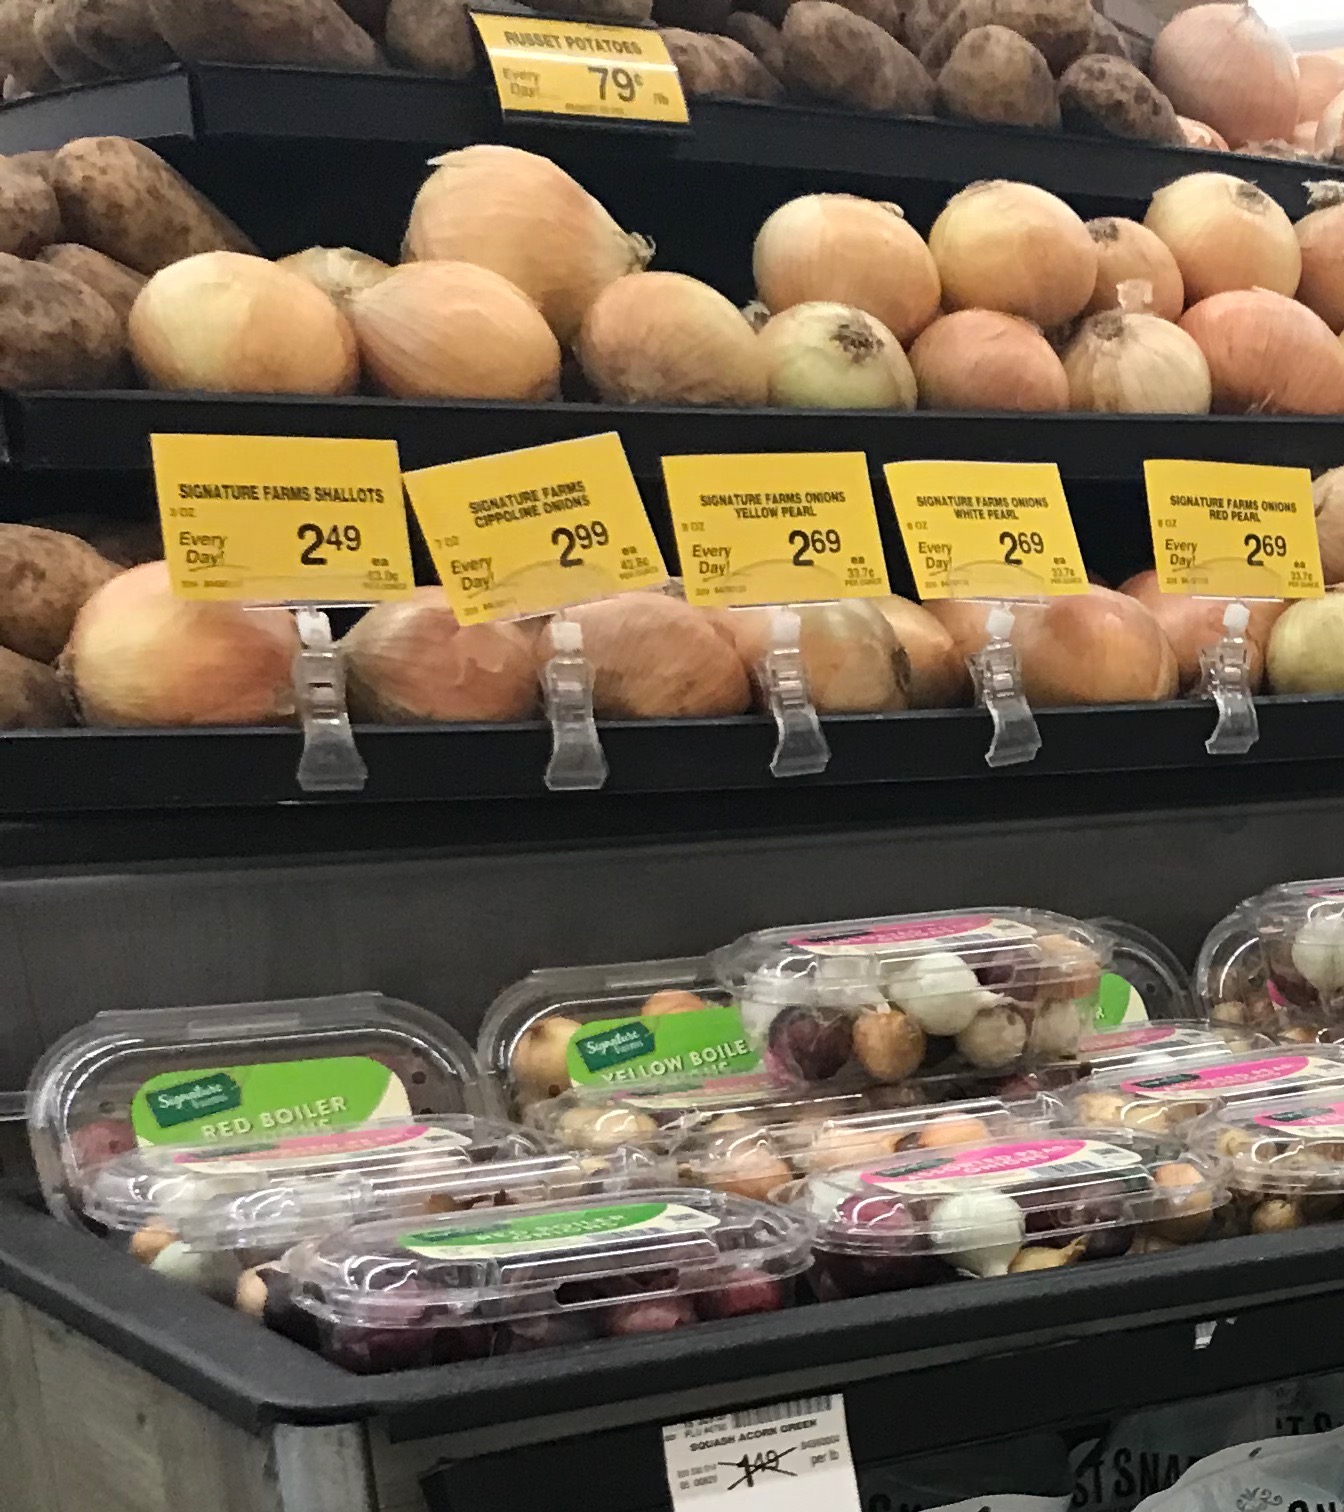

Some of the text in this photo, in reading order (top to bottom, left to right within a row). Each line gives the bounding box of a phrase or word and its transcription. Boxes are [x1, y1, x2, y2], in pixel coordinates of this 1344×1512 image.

[504, 31, 643, 55] RUSSET POTATOES
[178, 484, 385, 503] SIGNATURE FARMS SHALLOTS
[468, 480, 587, 514] SIGNATURE FARMS
[700, 491, 847, 507] SIGNATURE FARMS ONIONS
[916, 495, 1049, 509] SIGNATURE FARMS ONIONS
[735, 506, 817, 520] YELLOW PEARL
[1169, 495, 1297, 513] SIGNATURE FARMS ONIONS
[953, 508, 985, 520] WHITE
[1209, 510, 1229, 521] RED
[179, 531, 228, 551] Every
[918, 541, 953, 559] Every
[1165, 538, 1198, 554] Every
[692, 544, 732, 562] Every
[451, 555, 494, 576] Every
[689, 1039, 754, 1066] BOILE
[201, 1096, 347, 1142] RED BOILER
